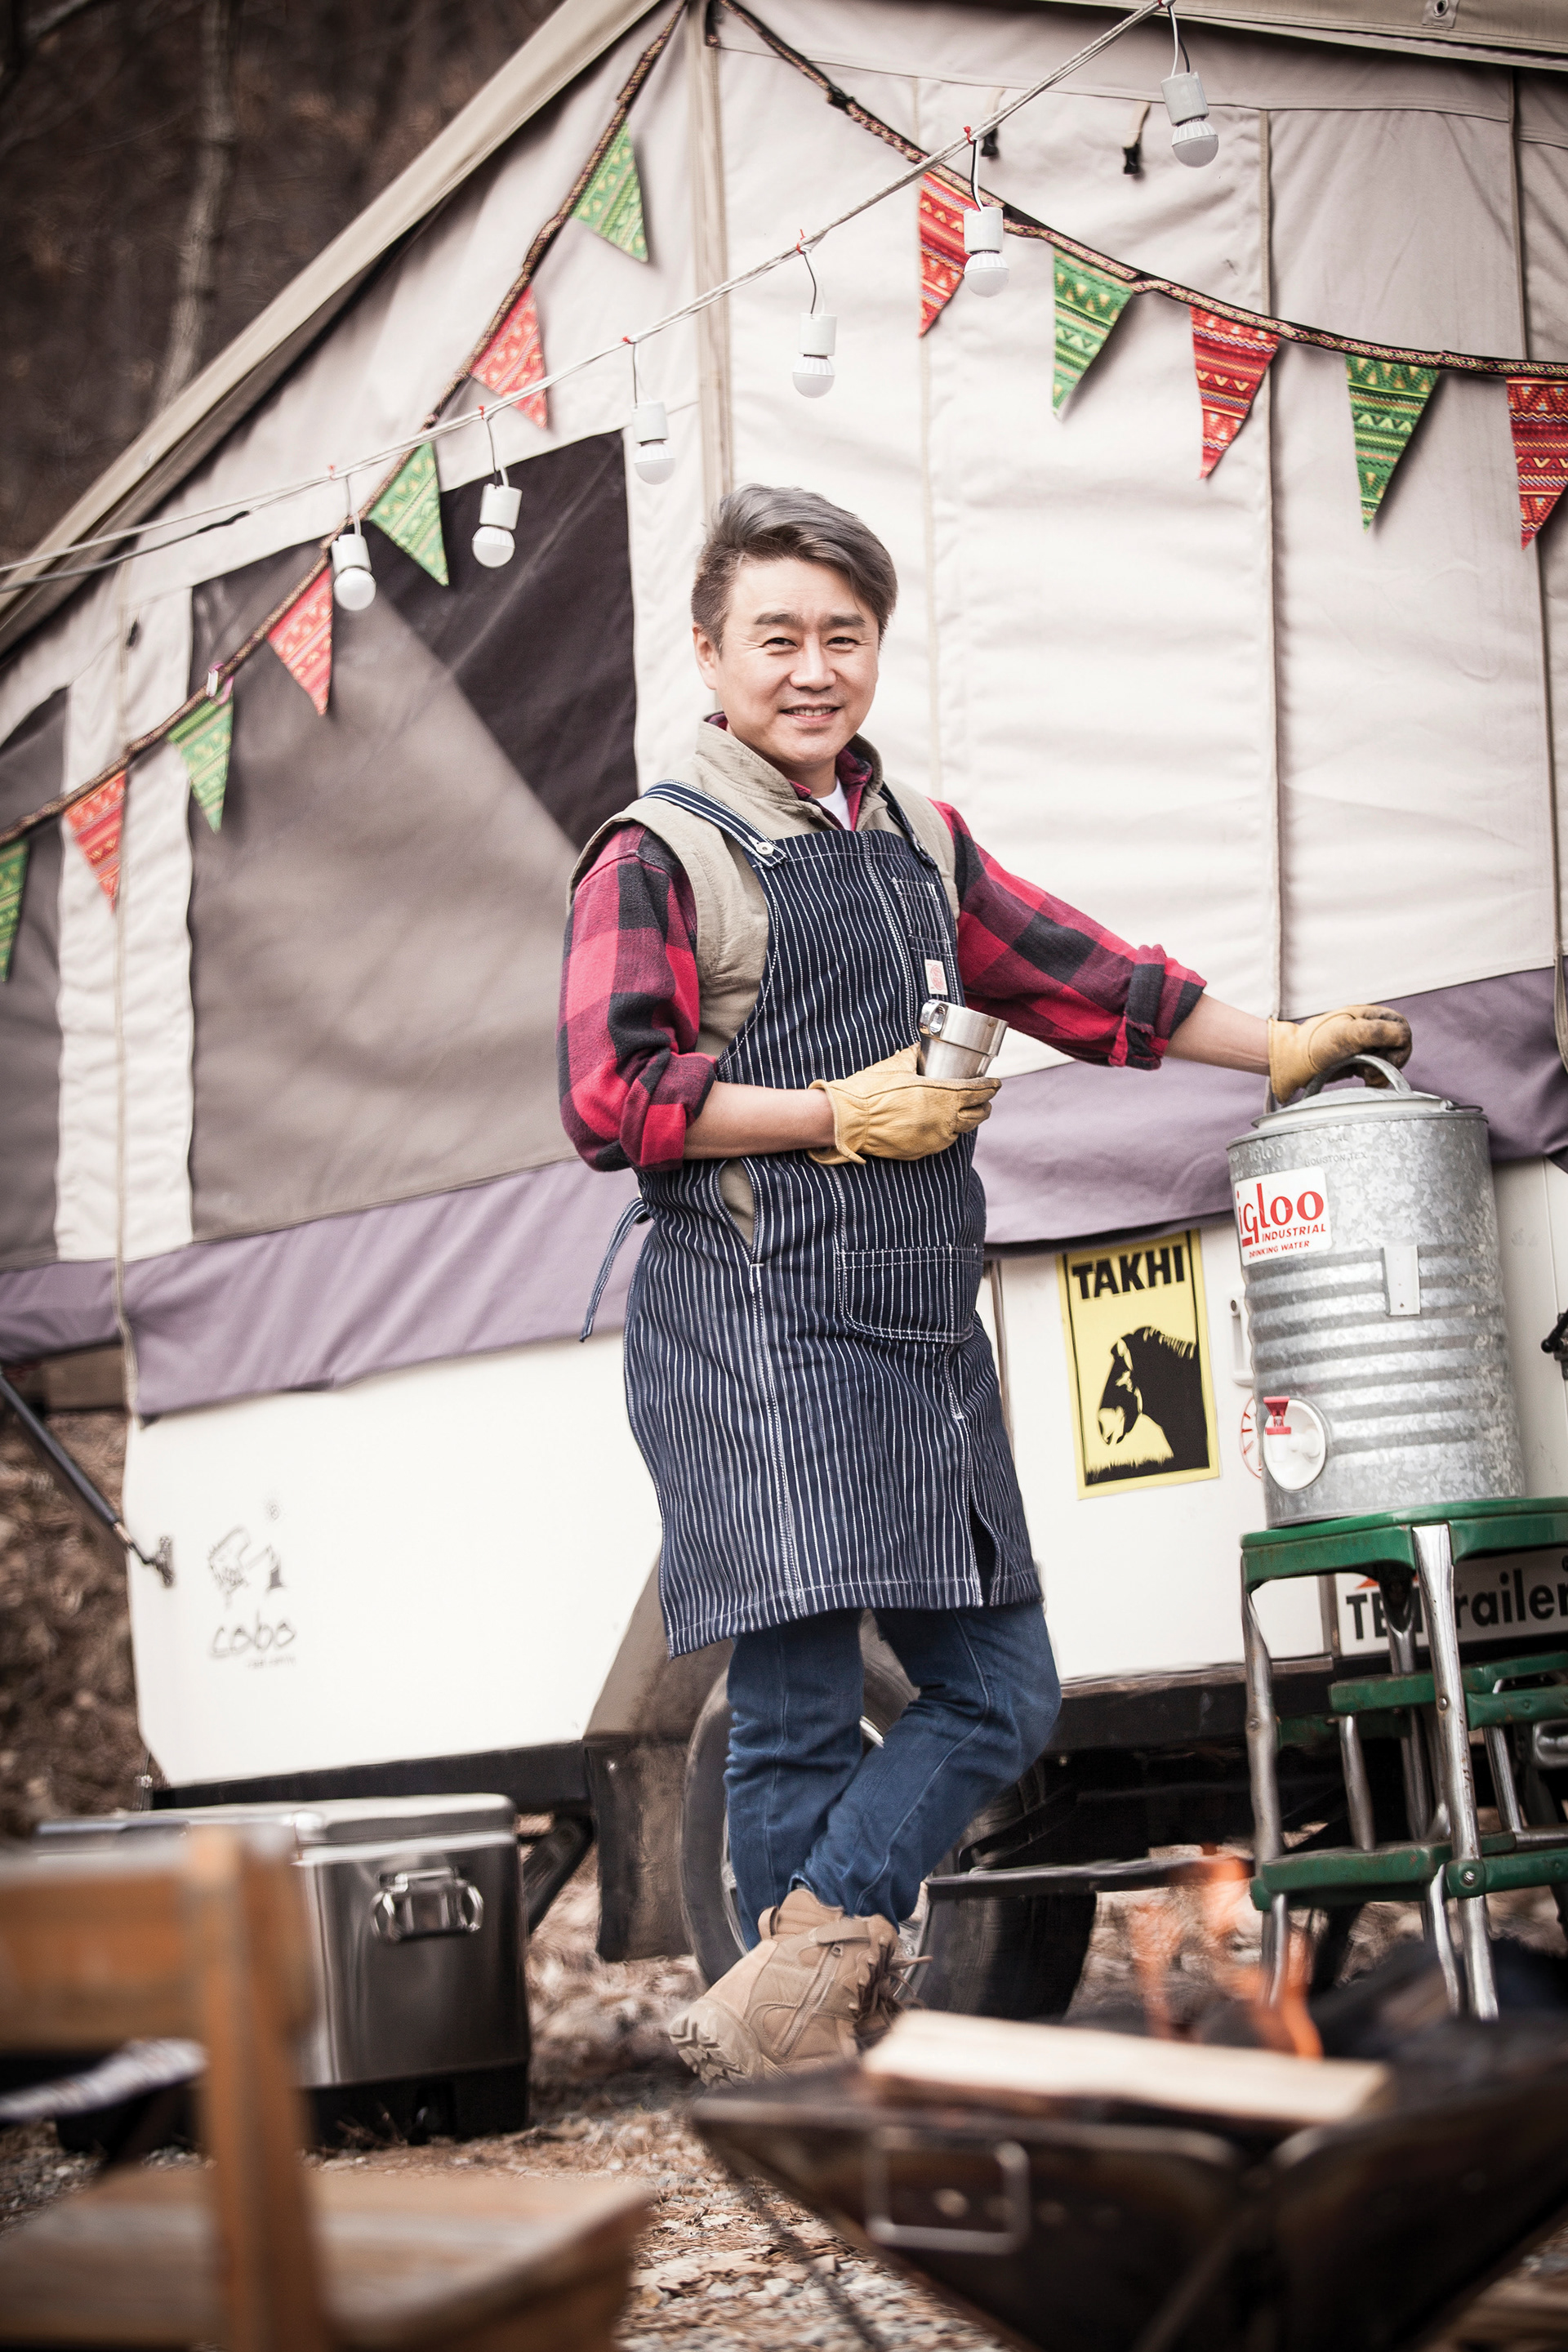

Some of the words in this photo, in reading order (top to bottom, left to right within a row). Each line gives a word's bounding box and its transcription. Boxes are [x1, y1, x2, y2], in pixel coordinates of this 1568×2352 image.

[1236, 1183, 1325, 1247] igloo
[1262, 1223, 1326, 1242] INDUSTRIAL
[1249, 1245, 1279, 1258] DRINKING
[1281, 1241, 1310, 1251] WATER
[1072, 1245, 1185, 1299] TAKHI
